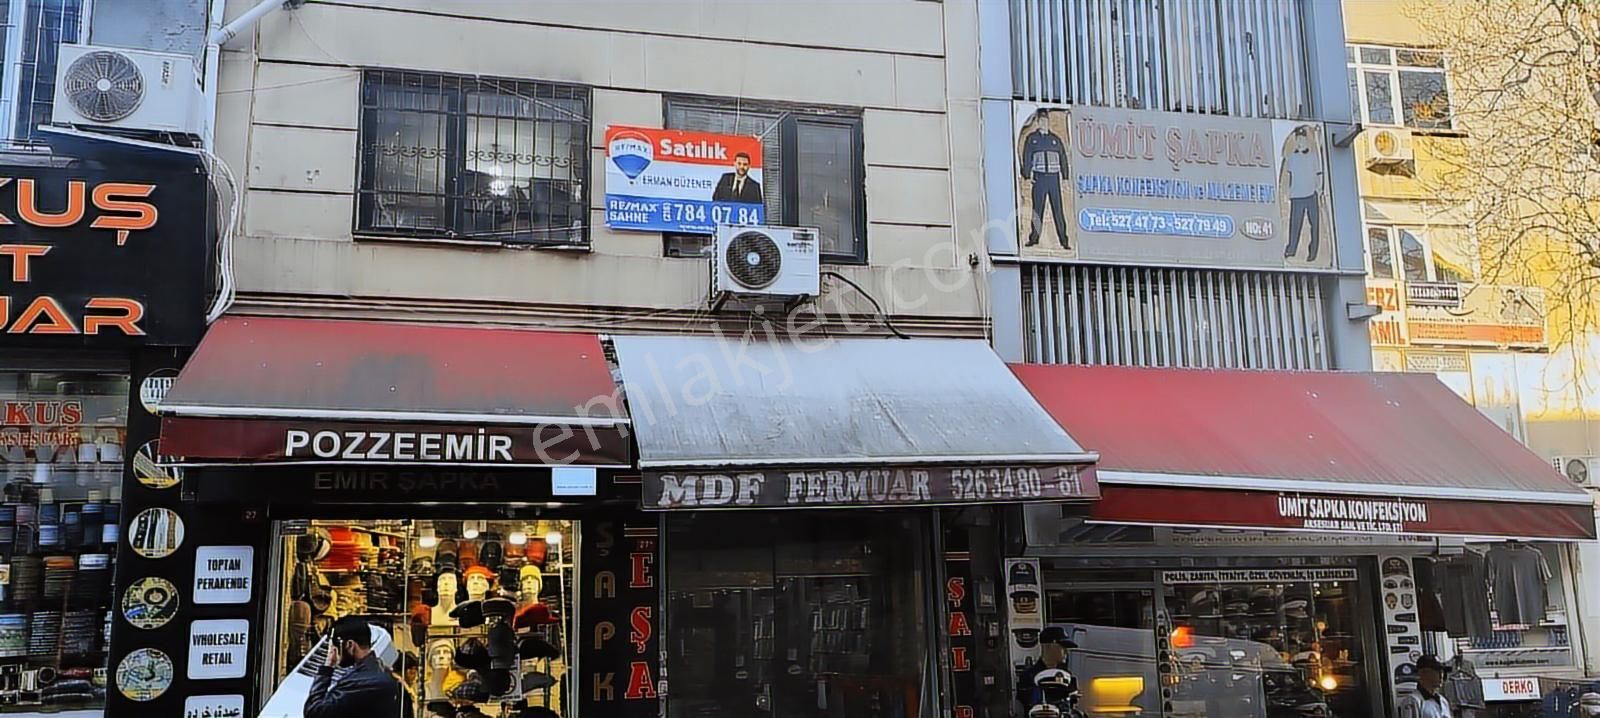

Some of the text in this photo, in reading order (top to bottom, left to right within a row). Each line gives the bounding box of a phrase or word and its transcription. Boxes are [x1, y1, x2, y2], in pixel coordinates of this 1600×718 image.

[659, 138, 728, 160] Satılık
[1077, 116, 1271, 171] ÜMİT ŞAPKA
[642, 175, 712, 189] ERMAN DÜZENER
[1077, 174, 1112, 199] ŞAPKA
[0, 178, 158, 246] UŞ
[609, 200, 658, 212] RE/MAX
[609, 211, 649, 223] SAHNE
[674, 203, 706, 222] 784
[711, 206, 732, 225] 07
[739, 207, 758, 225] 84
[1088, 212, 1109, 229] Tel:
[1111, 214, 1132, 230] 527
[1134, 214, 1148, 229] 47
[1151, 215, 1166, 230] 73
[1174, 216, 1195, 231] 527
[0, 296, 146, 335] AR
[0, 401, 82, 432] KUŞ
[285, 428, 513, 461] POZZEEMİR
[657, 472, 766, 507] MDF
[784, 470, 932, 504] FERMUAR
[1278, 492, 1308, 517] ÜMİT
[1349, 497, 1428, 522] KONFEKSİYON
[207, 558, 241, 571] TOPTAN
[197, 577, 249, 590] PERAKENDE
[624, 552, 656, 699] EŞA
[192, 633, 246, 646] WHOLESALE
[202, 653, 232, 665] RETAIL
[1502, 680, 1533, 695] DERKO
